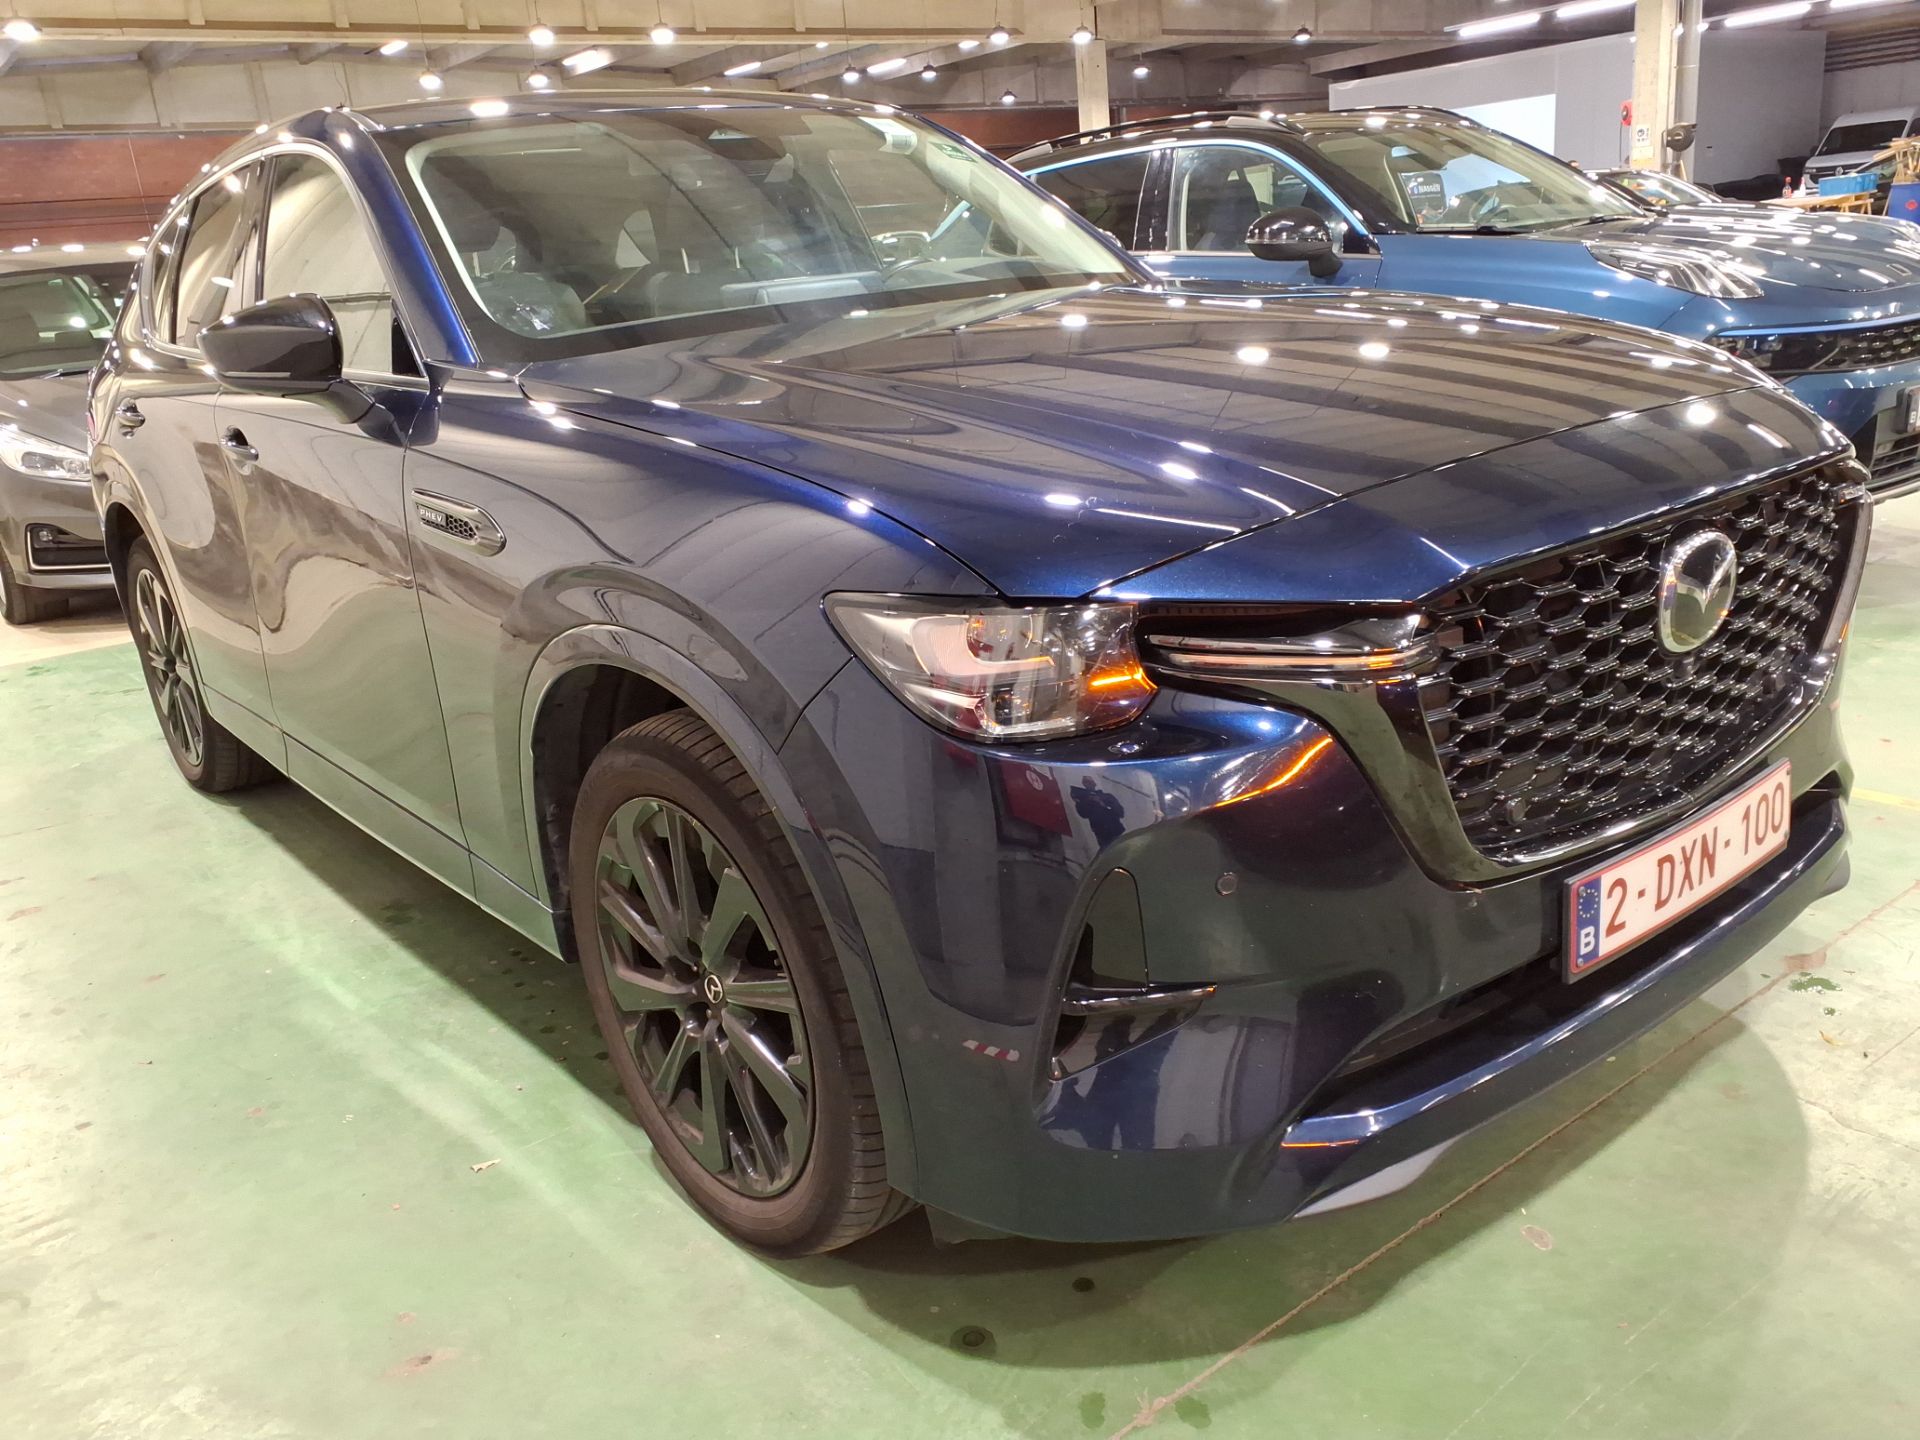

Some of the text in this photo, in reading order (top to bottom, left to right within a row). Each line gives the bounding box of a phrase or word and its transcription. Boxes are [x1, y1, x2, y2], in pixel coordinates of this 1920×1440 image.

[420, 509, 442, 522] PHEV
[1604, 781, 1785, 939] 2-DXN-100
[1579, 925, 1596, 956] B
